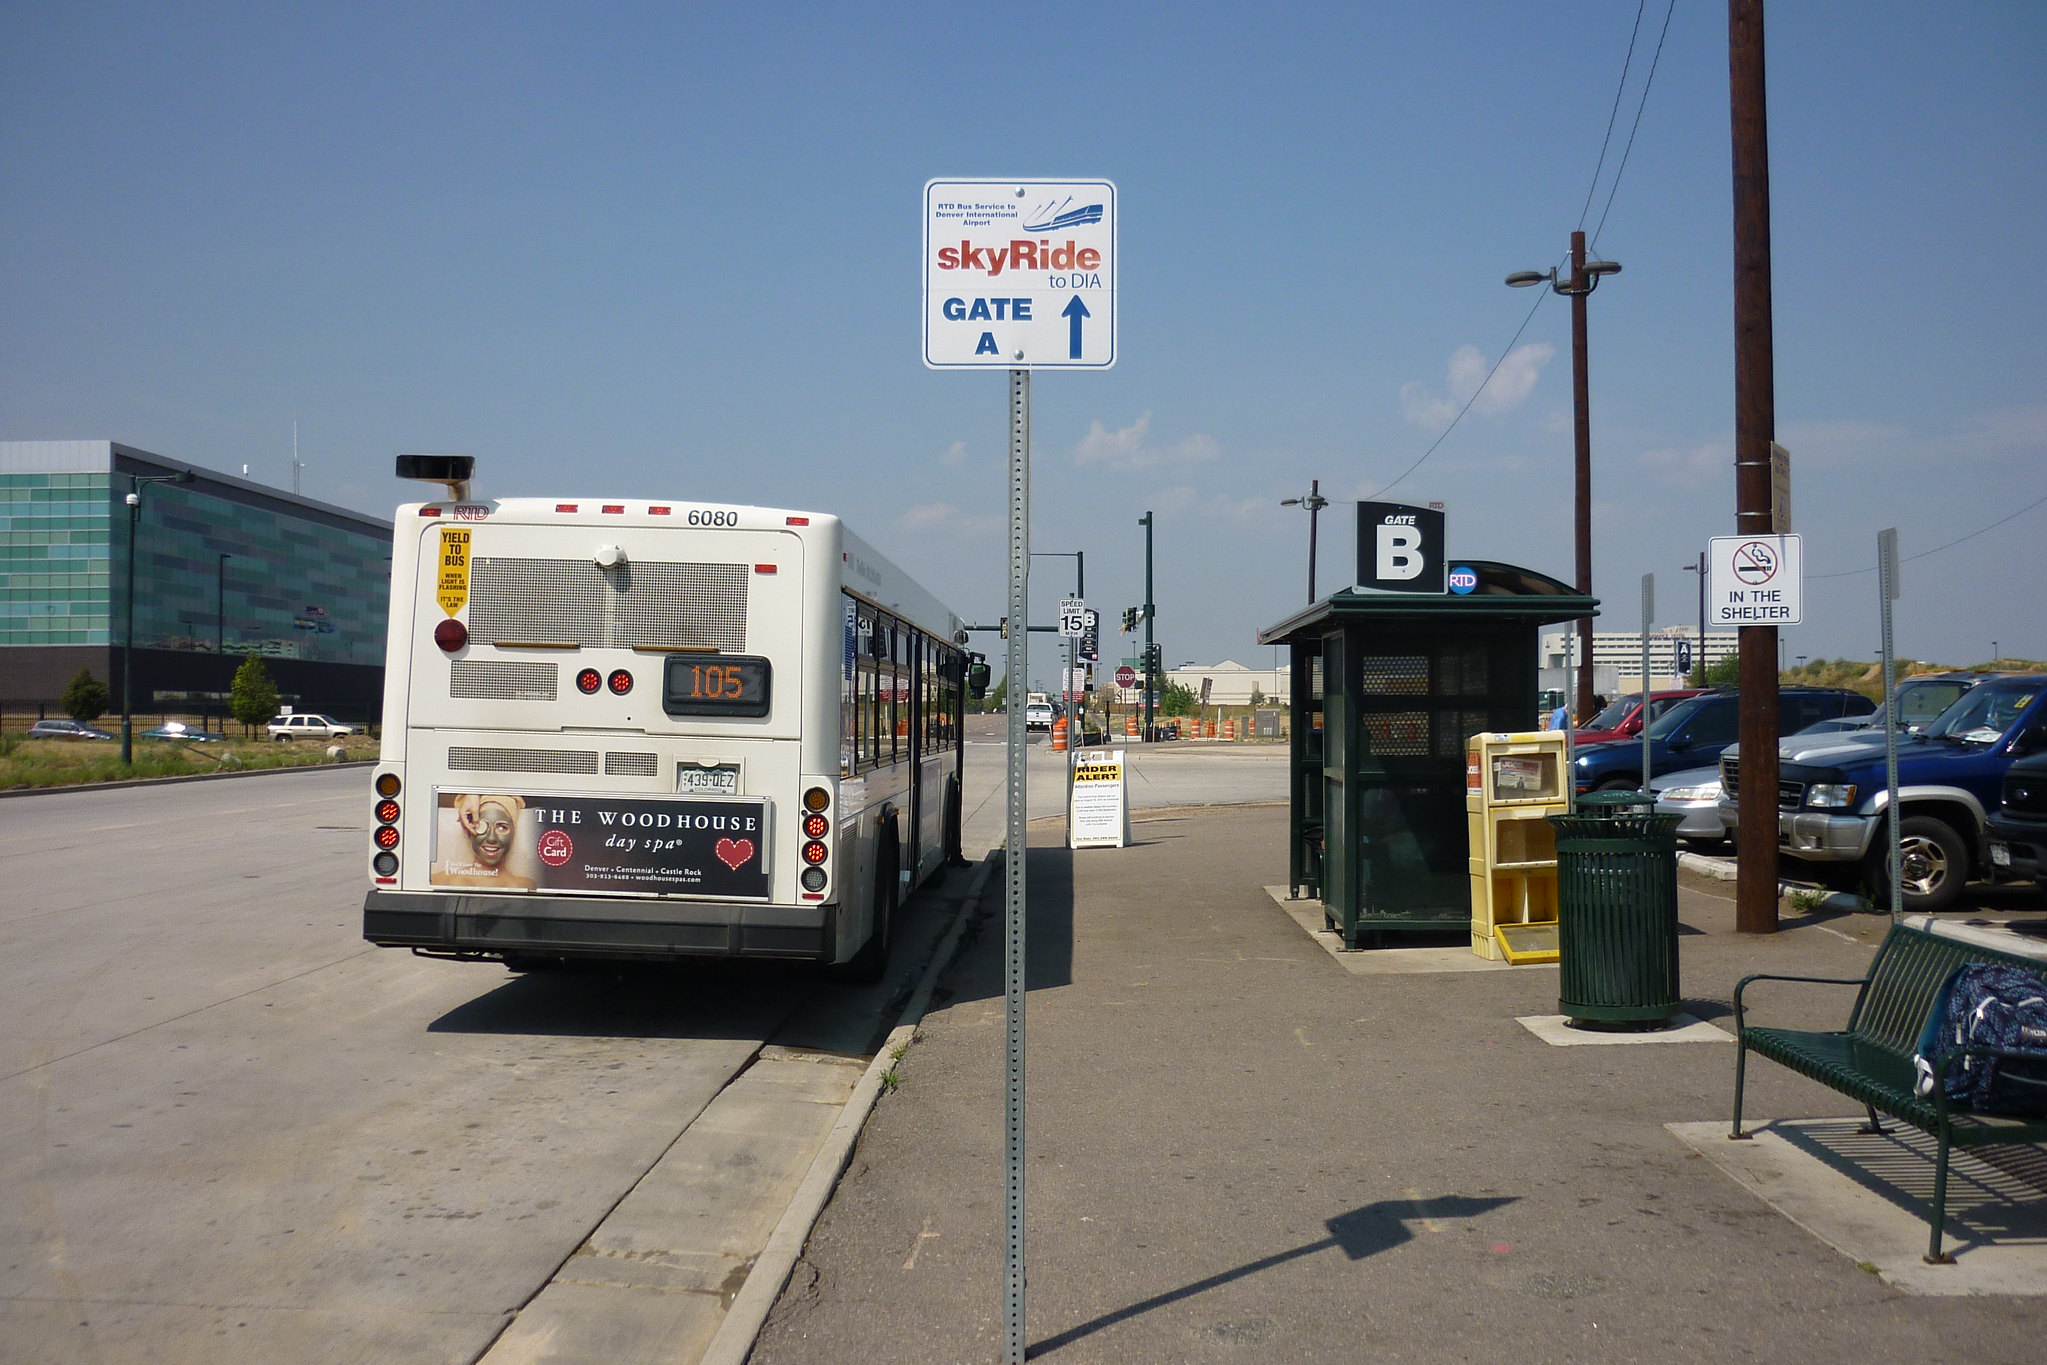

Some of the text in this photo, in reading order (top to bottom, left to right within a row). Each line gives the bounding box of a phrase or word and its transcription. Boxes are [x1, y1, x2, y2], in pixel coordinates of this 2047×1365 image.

[963, 219, 991, 227] Airport
[937, 240, 1100, 277] skyRide
[1049, 274, 1102, 289] to DIA
[942, 298, 1033, 321] GATE
[974, 332, 999, 355] A
[454, 505, 489, 520] RTD
[688, 510, 738, 526] 6080
[1384, 515, 1416, 525] GATE
[442, 532, 470, 543] YIELD
[449, 544, 462, 554] TO
[1376, 525, 1424, 580] B
[445, 556, 465, 566] BUS
[1449, 574, 1477, 587] RTD
[1729, 590, 1781, 603] IN THE
[1721, 606, 1790, 619] SHELTER
[1061, 615, 1083, 631] 15
[1084, 614, 1096, 627] B
[1680, 644, 1689, 654] A
[690, 665, 742, 698] 105
[1116, 673, 1135, 681] STOP
[535, 809, 756, 831] THE WOODHOUSE
[547, 837, 564, 847] Gift
[605, 834, 637, 852] day
[543, 847, 567, 857] Card
[616, 866, 654, 874] Centennial
[635, 875, 701, 884] woodhousespas.com
